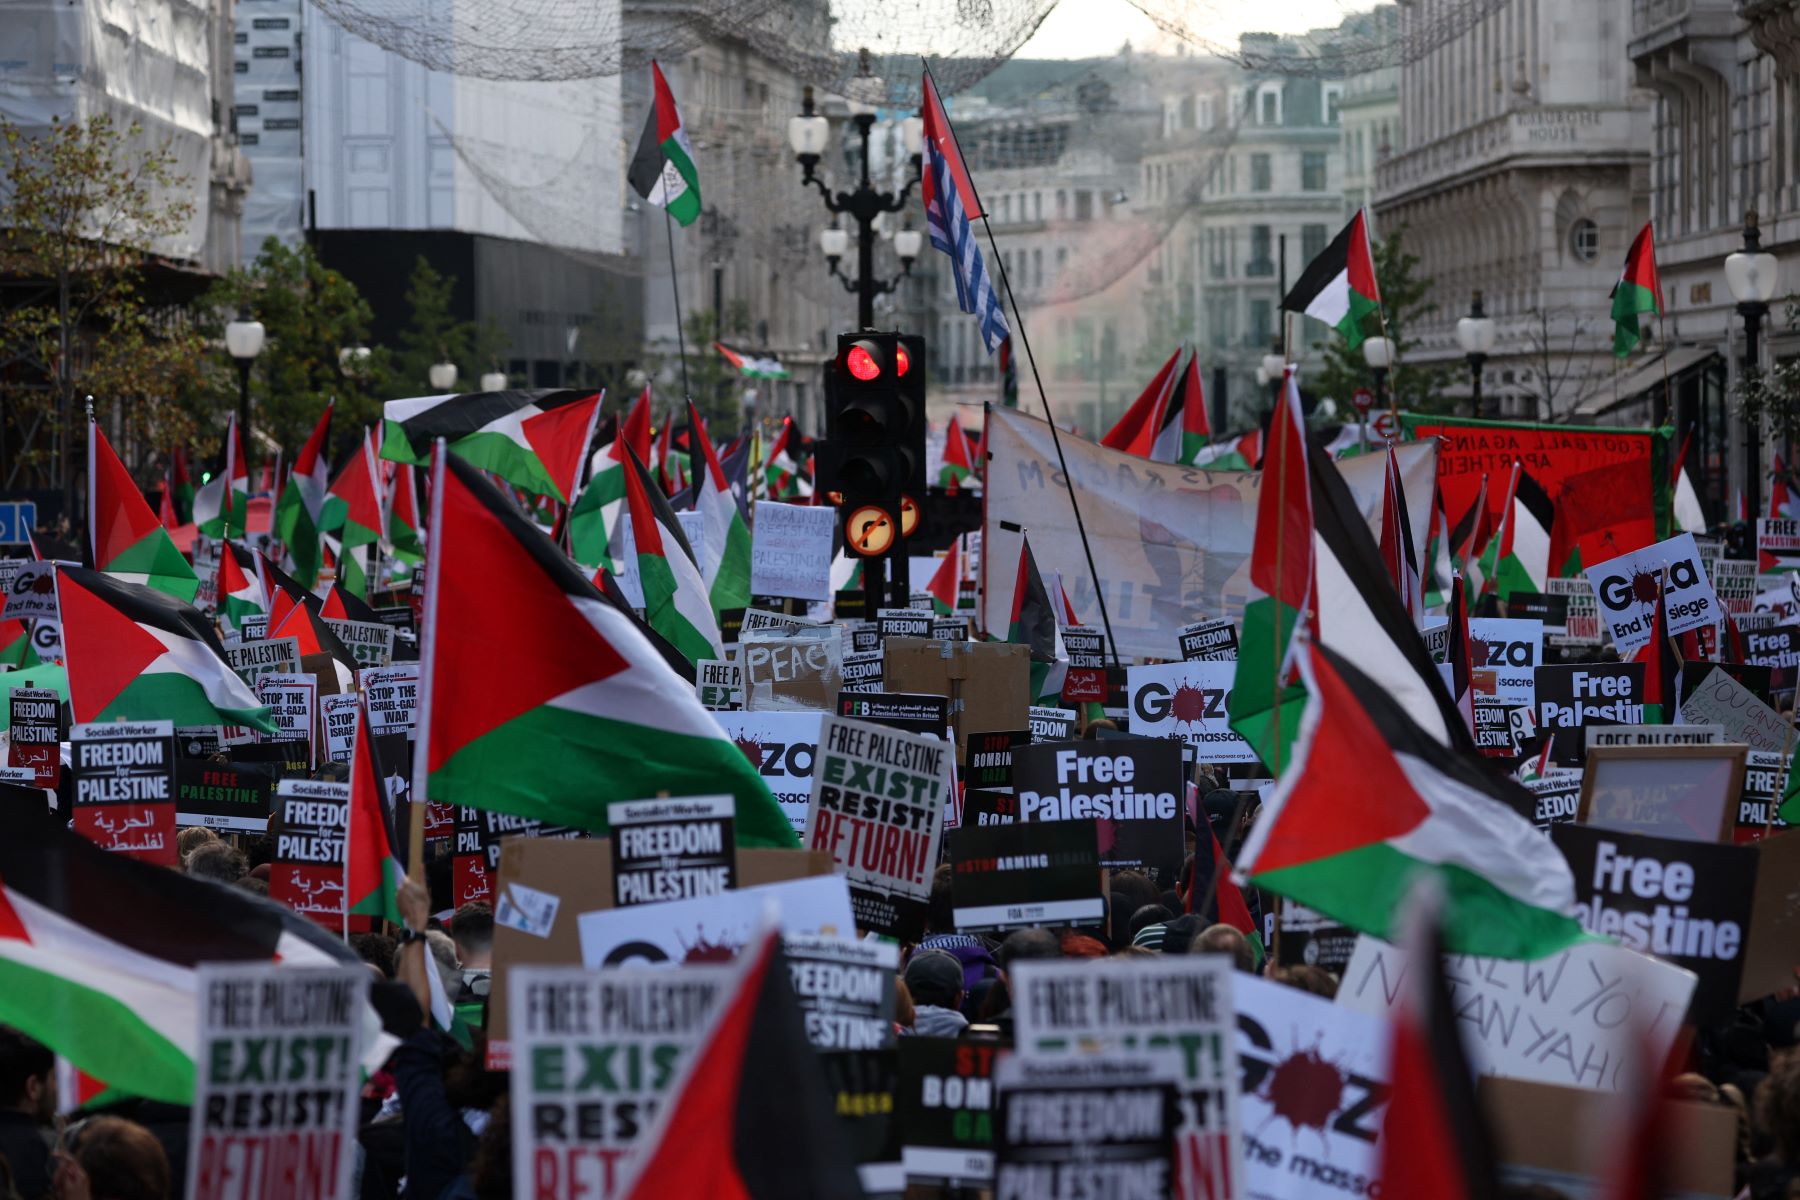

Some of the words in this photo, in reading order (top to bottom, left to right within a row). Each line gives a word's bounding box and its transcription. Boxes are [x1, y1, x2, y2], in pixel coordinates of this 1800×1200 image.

[1765, 521, 1797, 535] FREE
[753, 550, 830, 568] PALESTINIAN
[1600, 559, 1699, 610] Gza
[1716, 577, 1755, 588] EXIST!
[747, 613, 767, 629] FREE
[882, 621, 927, 633] FREEDOM
[1185, 624, 1207, 633] Socialist
[1207, 620, 1225, 629] Worker
[1613, 617, 1641, 638] End
[1643, 612, 1656, 629] th
[1668, 598, 1708, 620] siege
[1740, 616, 1776, 630] PALESTINE
[342, 623, 389, 644] PALESTINE
[1063, 636, 1100, 650] FREEDOM
[1184, 629, 1231, 650] FREEDOM
[1748, 633, 1790, 653] Free
[240, 642, 294, 665] PALESTINE
[1744, 648, 1799, 668] alestin
[747, 645, 836, 683] PEAC
[842, 661, 882, 679] REEDOM
[372, 678, 394, 686] Party
[374, 672, 407, 680] Socialist
[703, 664, 728, 684] FREE
[369, 687, 394, 701] STOP
[397, 685, 416, 698] THE
[1572, 671, 1632, 697] Free
[1705, 671, 1750, 709] YOU
[260, 693, 283, 704] STOP
[286, 693, 304, 704] THE
[330, 702, 354, 710] Party
[370, 698, 416, 712] ISRAEL-GAZ
[843, 700, 870, 715] PFB
[1134, 683, 1232, 723] Gz
[13, 701, 56, 718] FREEDOM
[271, 705, 307, 716] AEL-GAZA
[329, 712, 355, 726] STOP
[384, 711, 409, 724] WAR
[1044, 709, 1065, 718] Worker
[1475, 708, 1505, 723] EEDOM
[1541, 699, 1644, 728] Palestin
[27, 717, 35, 726] for
[275, 716, 295, 728] WAR
[372, 727, 387, 735] FOR
[1029, 720, 1067, 737] EEDOM
[11, 725, 58, 743] PALESTINE
[85, 728, 125, 737] Socialist
[125, 726, 157, 735] Worker
[1192, 731, 1246, 743] massac
[1477, 731, 1510, 746] LESTINE
[80, 741, 163, 768] FREEDOM
[332, 752, 346, 760] FOR
[828, 723, 866, 757] FREE
[867, 732, 944, 776] PALESTINE
[974, 751, 1012, 767] BOMBIN
[286, 760, 307, 771] Aqsa
[760, 742, 818, 777] za
[1056, 750, 1135, 784] Free
[116, 765, 130, 778] for
[203, 769, 238, 787] FREE
[822, 755, 941, 807] EXIST!
[77, 776, 170, 802] PALESTINE
[180, 783, 258, 803] PALESTINE
[292, 784, 331, 795] Socialist
[332, 786, 348, 796] Wor
[819, 785, 935, 833] RESIST!
[1019, 785, 1176, 822] Palestine
[1536, 793, 1579, 819] EEDO
[94, 810, 155, 834] الحرية
[204, 817, 215, 825] FOA
[284, 800, 347, 828] FREEDO
[318, 826, 333, 838] for
[620, 821, 722, 859] FREEDOM
[277, 834, 343, 862] PALEST
[812, 808, 931, 885] RETURN!
[1592, 839, 1695, 902] Free
[291, 869, 344, 895] حرية
[616, 865, 730, 905] PALESTINE
[853, 895, 896, 913] ALESTINE
[855, 905, 900, 921] OLIDARITY
[857, 913, 892, 928] MPAIGN
[208, 979, 254, 1029] FREE
[527, 982, 588, 1035] FREE
[1029, 976, 1088, 1029] FREE
[804, 1010, 889, 1051] ESTINE
[211, 1035, 350, 1084] EXIST!
[532, 1043, 679, 1094] EXIS
[956, 1045, 993, 1076] ST
[206, 1088, 346, 1129] RESIST!
[1005, 1089, 1164, 1145] FREEDOM
[953, 1109, 993, 1143] GA
